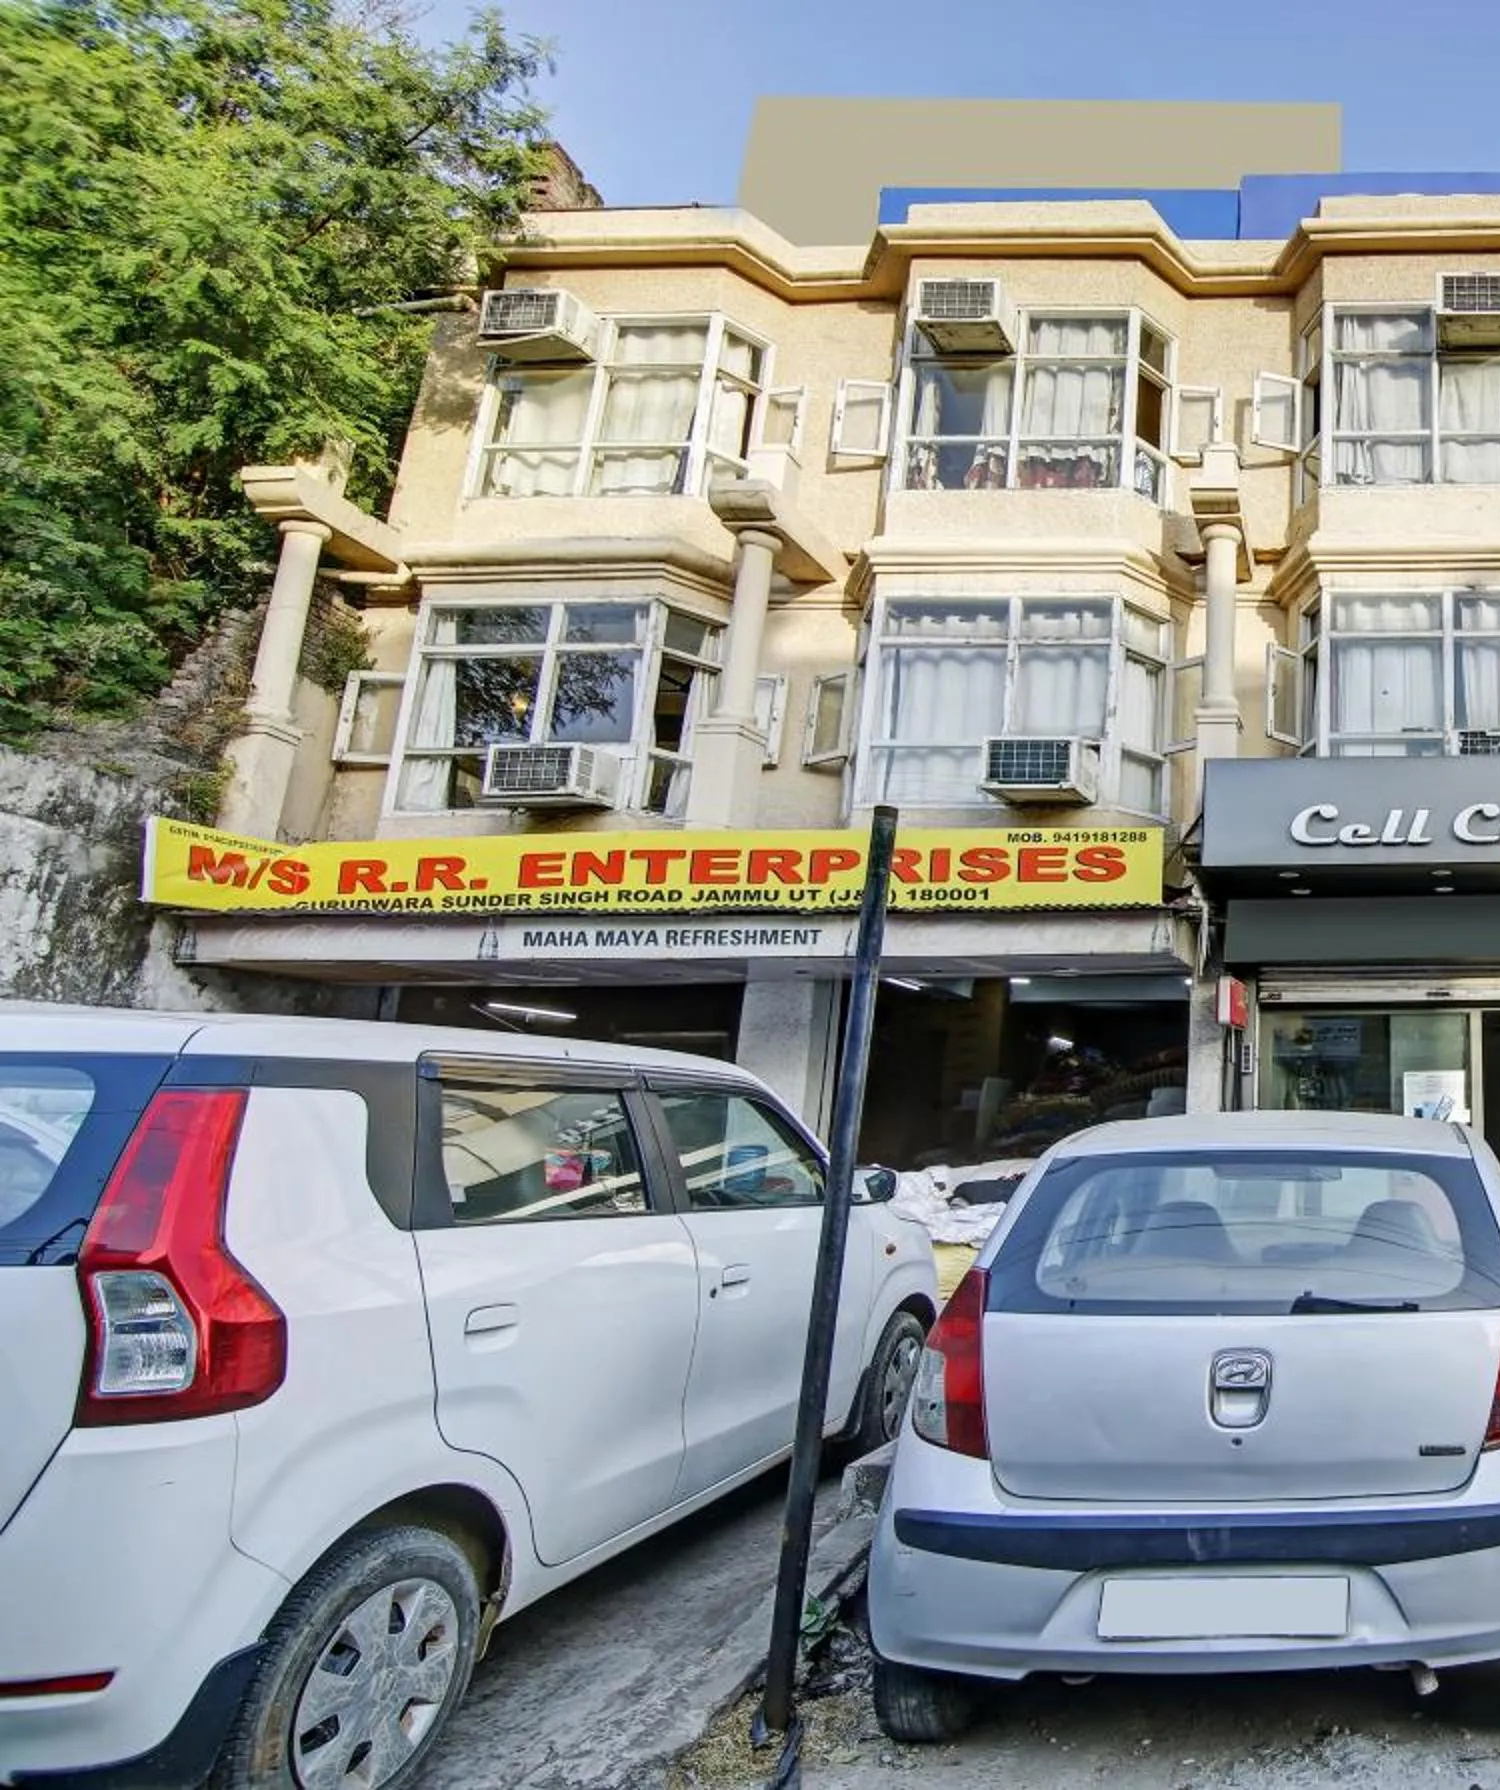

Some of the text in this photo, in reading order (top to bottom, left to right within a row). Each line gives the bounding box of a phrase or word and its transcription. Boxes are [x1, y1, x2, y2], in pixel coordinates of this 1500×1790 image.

[1290, 803, 1433, 846] Cell
[1007, 831, 1148, 844] MOB. 9419181288
[187, 845, 1128, 896] M/S R.R. ENTERPRISES
[295, 887, 991, 911] GURUDWARA SUNDER SINGH ROAD JAMMU UT (J&) 180001
[523, 928, 822, 947] MAHA MAYA REFRESHMENT
